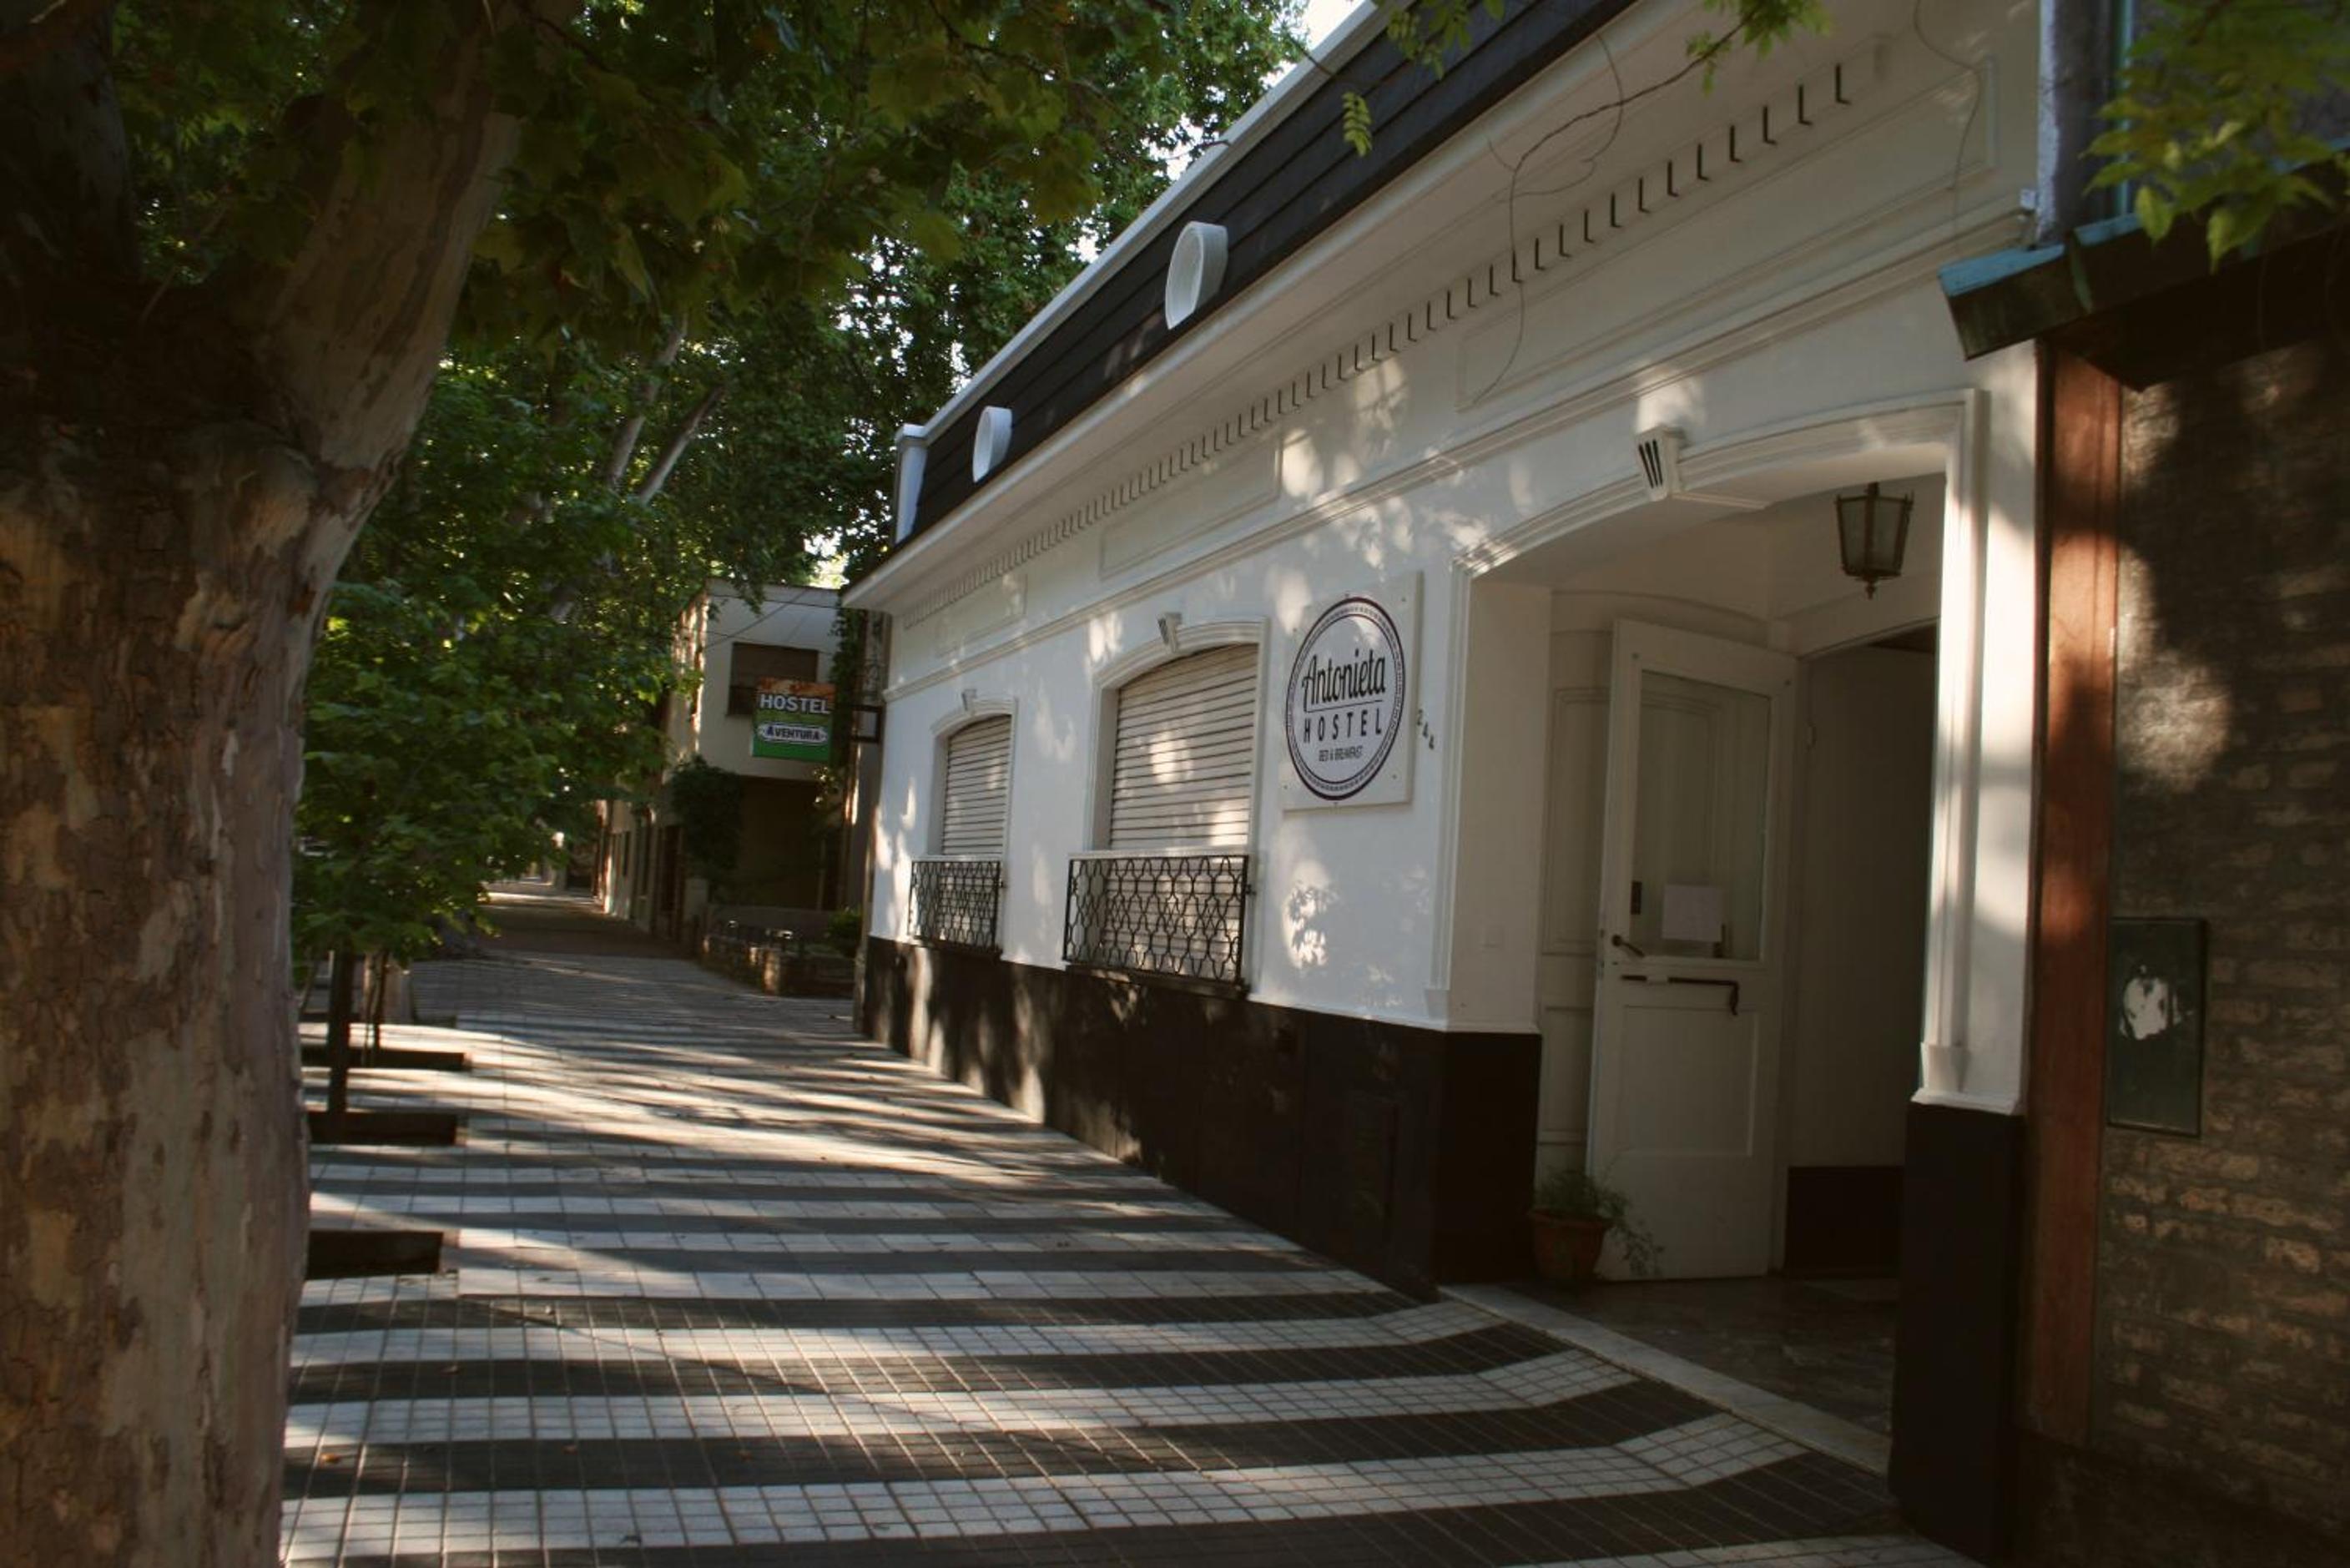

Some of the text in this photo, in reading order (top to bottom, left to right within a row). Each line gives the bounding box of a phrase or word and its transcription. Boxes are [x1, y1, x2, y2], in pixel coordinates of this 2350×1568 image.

[1301, 648, 1386, 713] Antonieta
[759, 693, 830, 714] HOSTEL
[1304, 708, 1382, 744] HOSTEL
